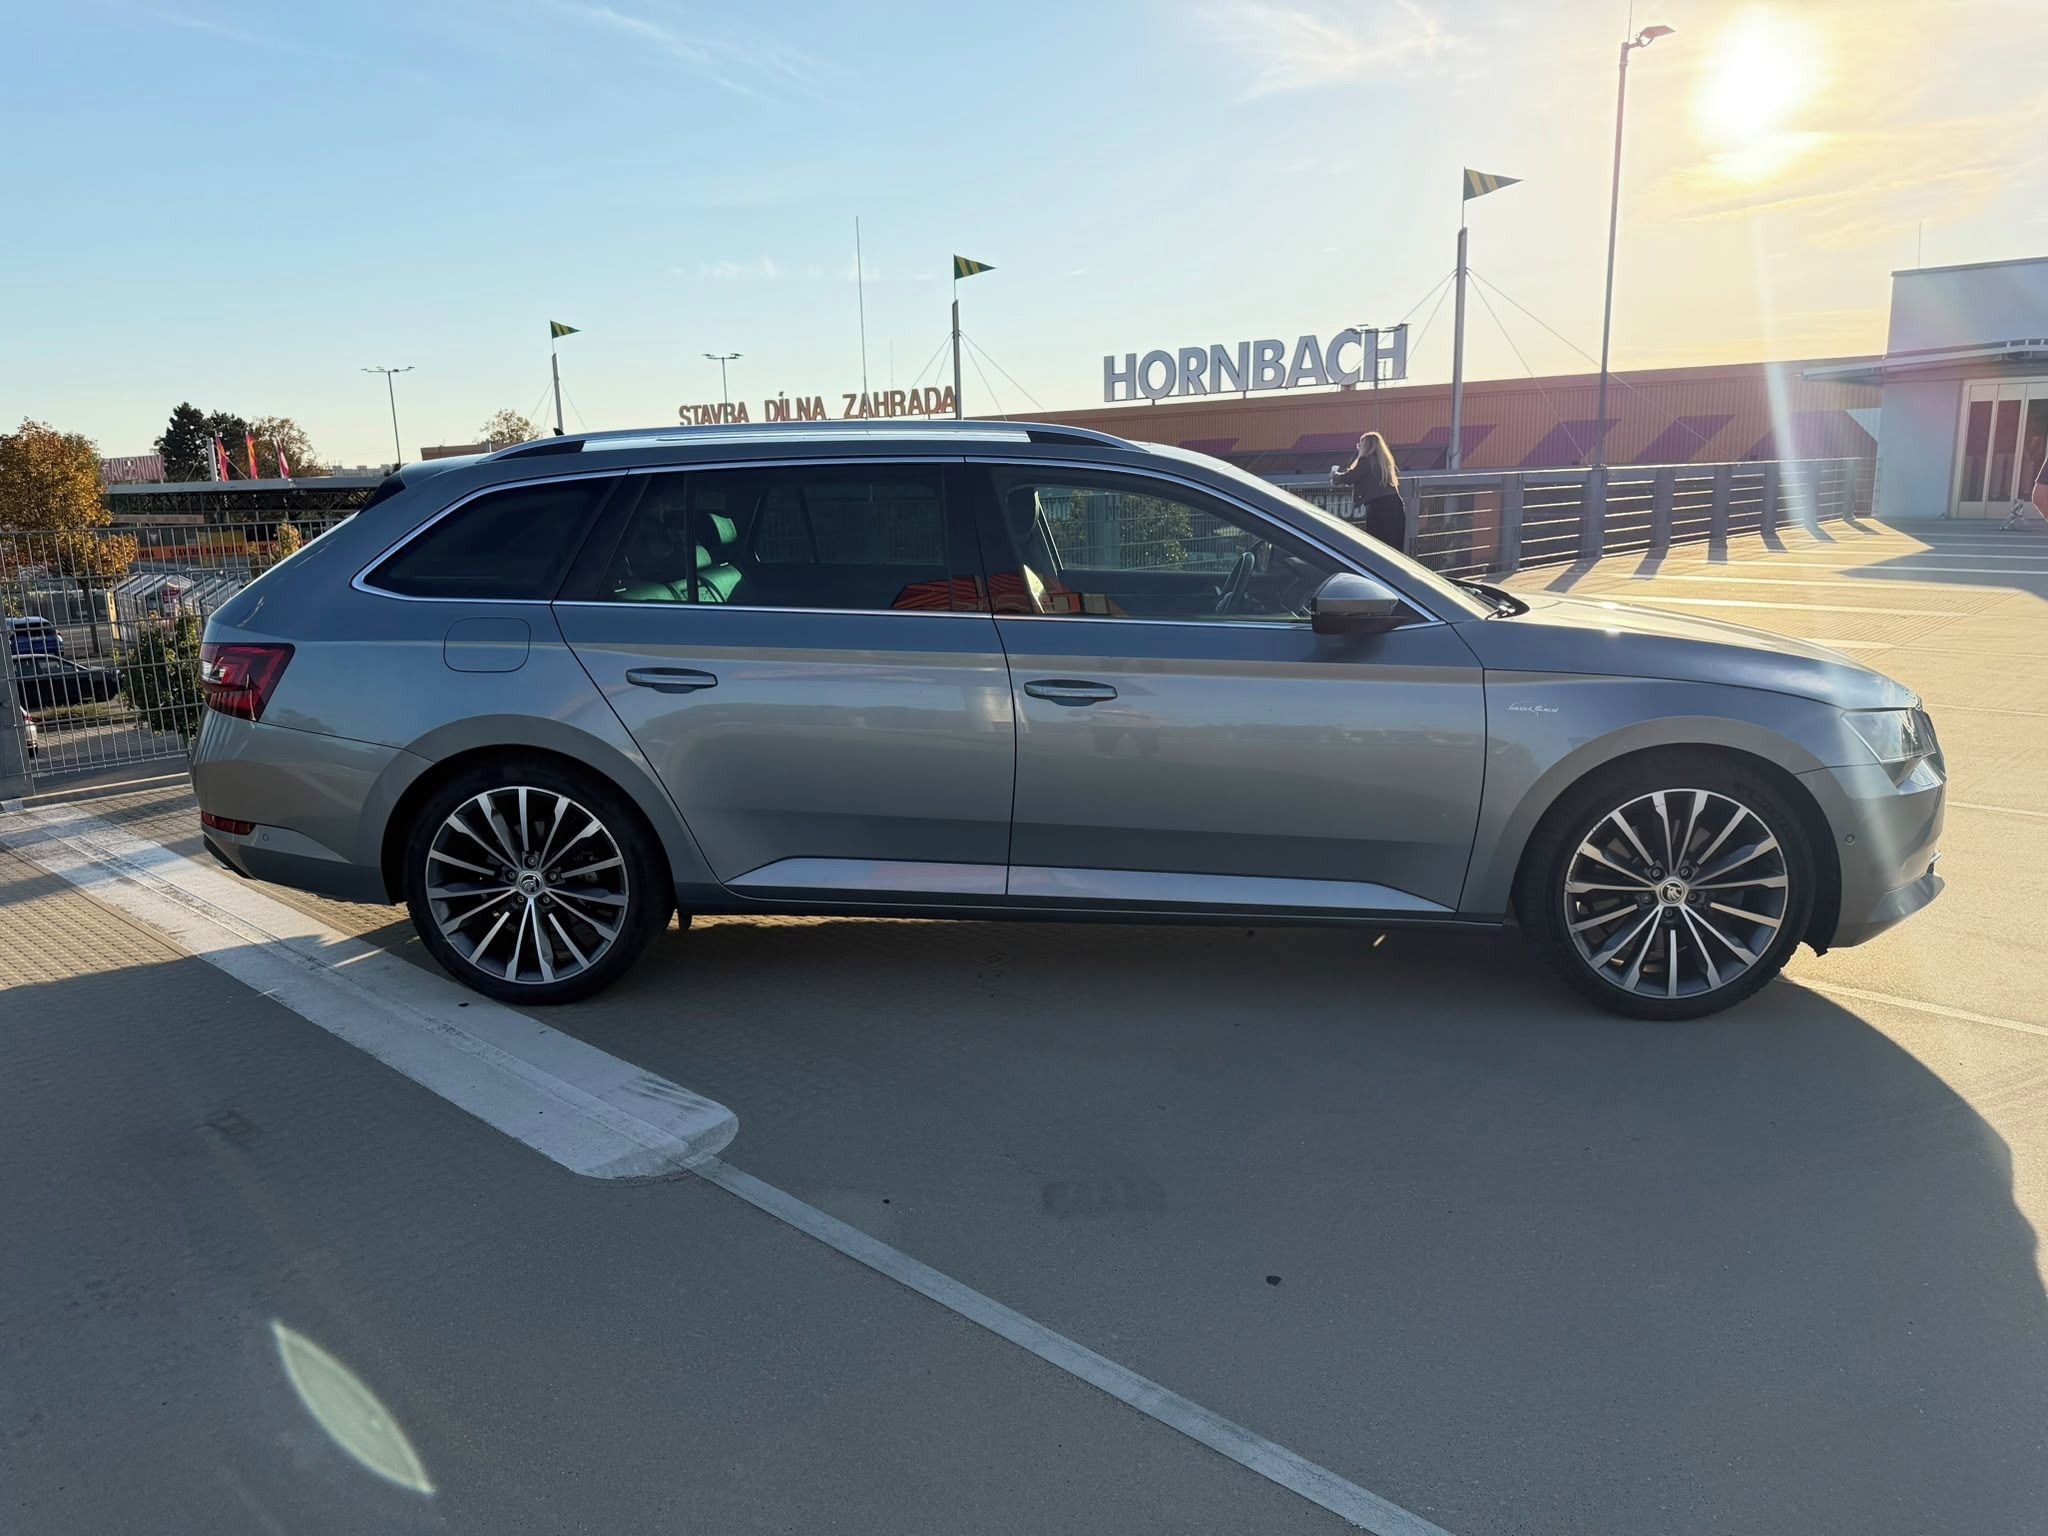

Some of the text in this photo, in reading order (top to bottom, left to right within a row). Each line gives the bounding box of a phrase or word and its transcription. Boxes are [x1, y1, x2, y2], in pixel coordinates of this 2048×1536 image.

[1103, 324, 1408, 402] HORNBACH
[679, 386, 957, 426] STAVBA DÍLNA ZAHRADA
